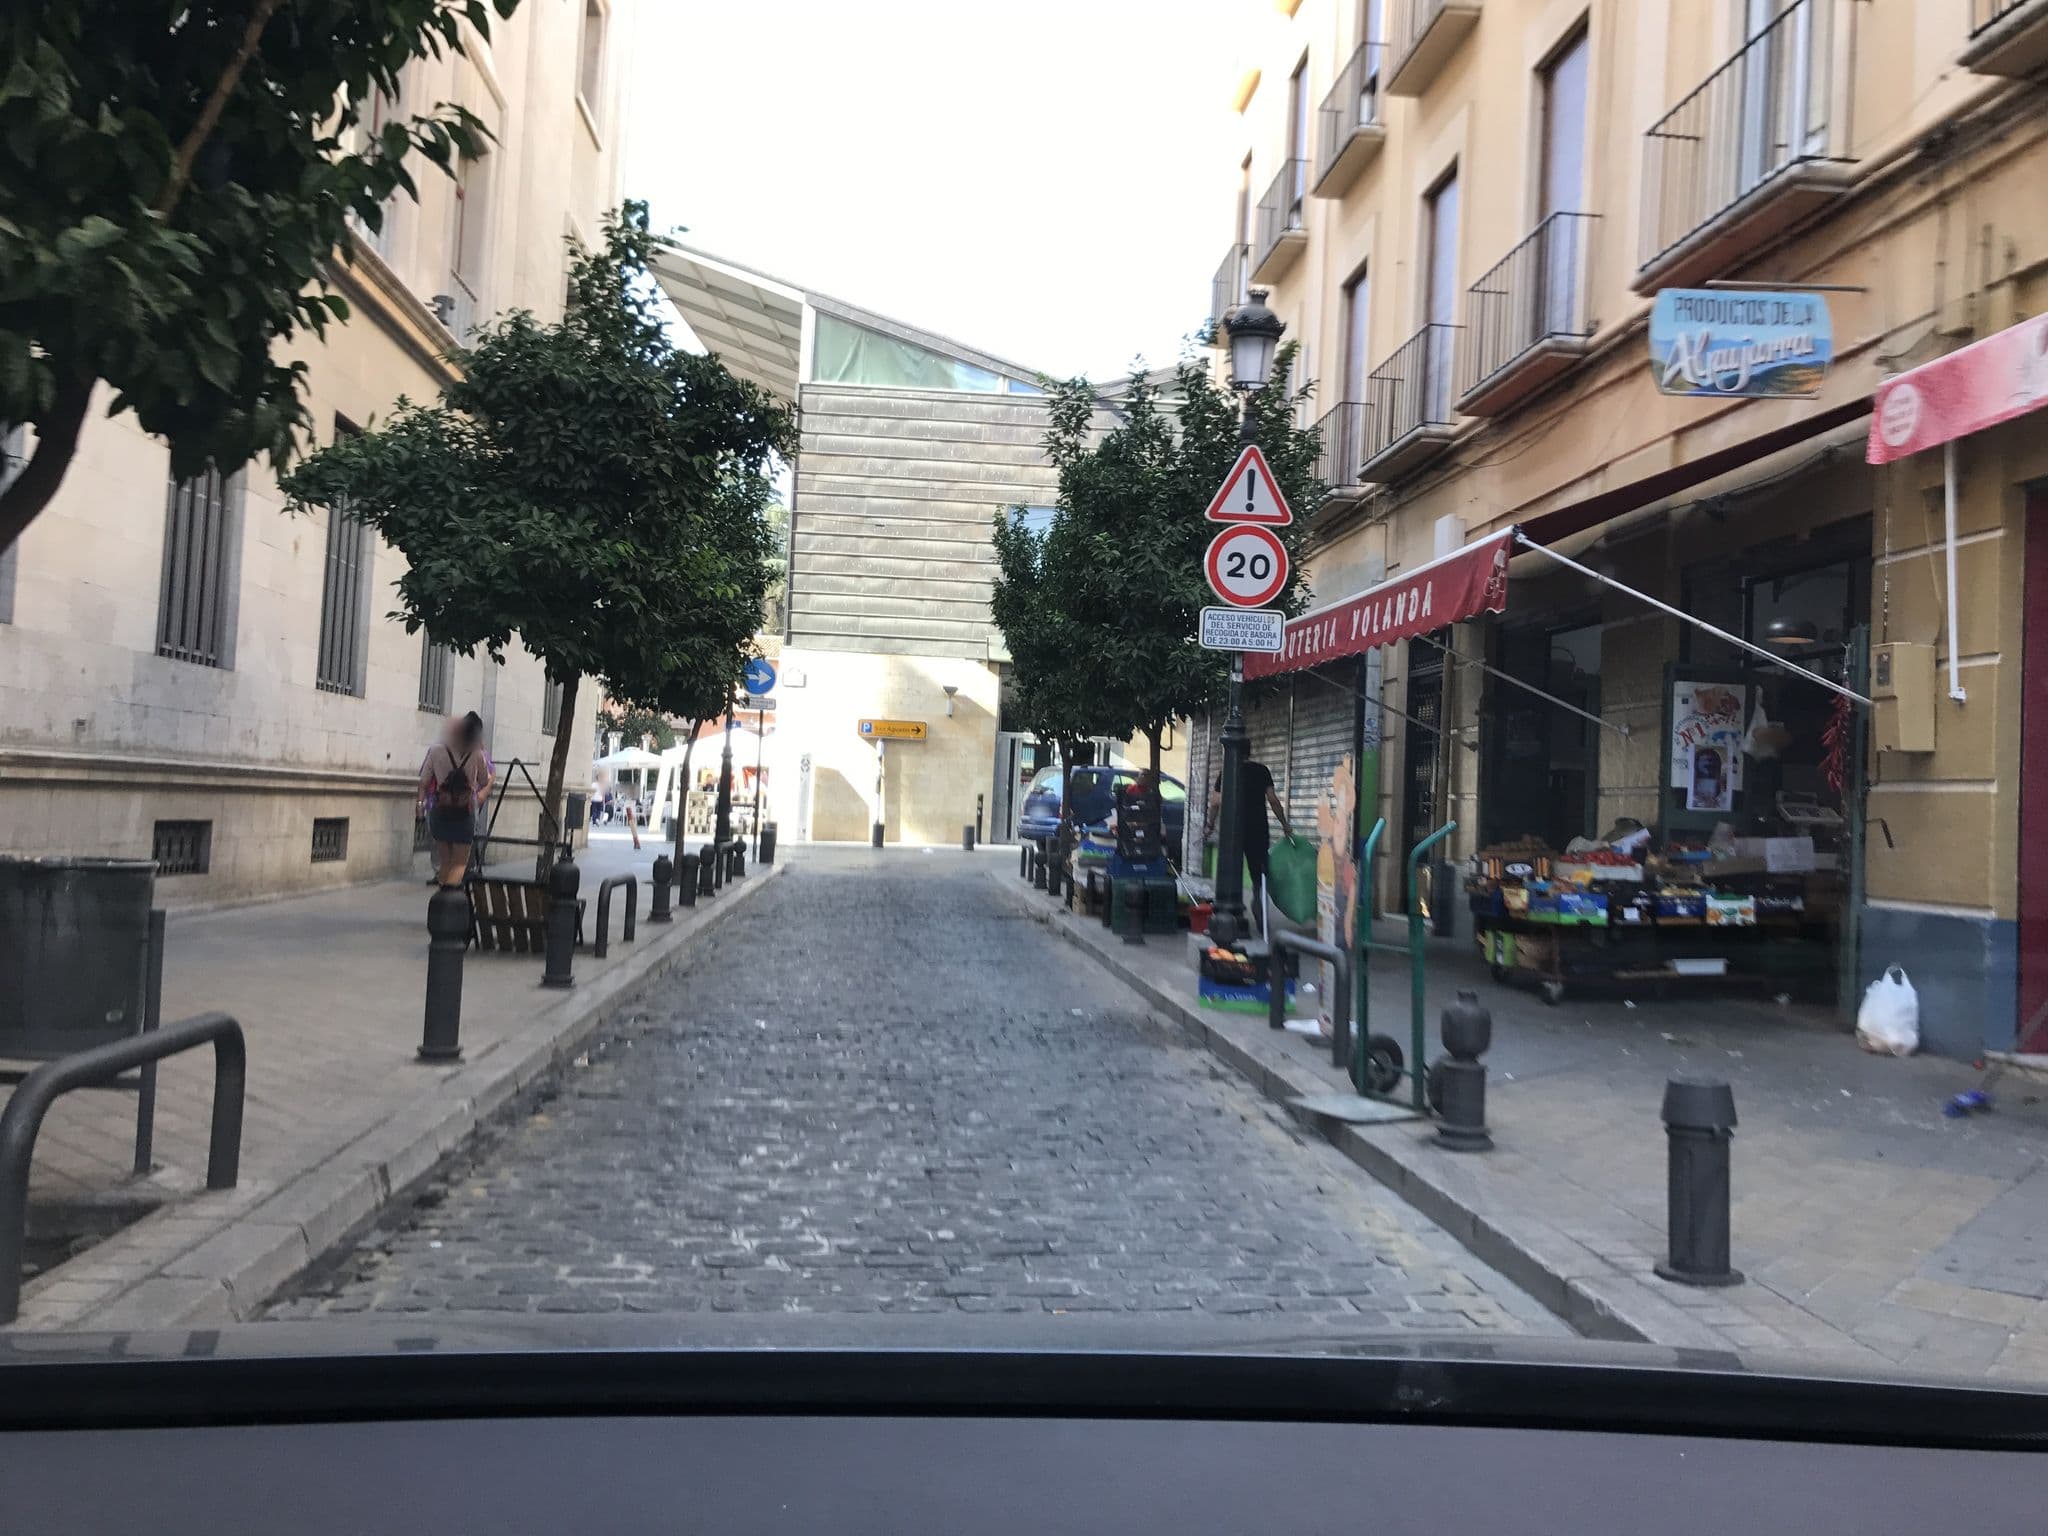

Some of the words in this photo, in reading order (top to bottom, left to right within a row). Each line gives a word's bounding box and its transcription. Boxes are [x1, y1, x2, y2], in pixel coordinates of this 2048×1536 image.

[1674, 297, 1767, 325] PRODUCTOS
[1772, 301, 1789, 325] DE
[1661, 330, 1815, 392] Alpujarra
[1226, 552, 1271, 580] 20
[1211, 621, 1225, 629] DEL
[1227, 622, 1260, 630] SERVICIO
[1262, 623, 1271, 631] DE
[1236, 615, 1275, 624] VEHICULOS
[1272, 617, 1337, 664] RUTERIA
[1350, 581, 1433, 640] YOLANDA
[1206, 629, 1239, 637] RECOGIDA
[1240, 630, 1249, 638] DE
[1250, 631, 1277, 640] BASURA
[1206, 637, 1218, 645] DE
[1241, 638, 1248, 646] A
